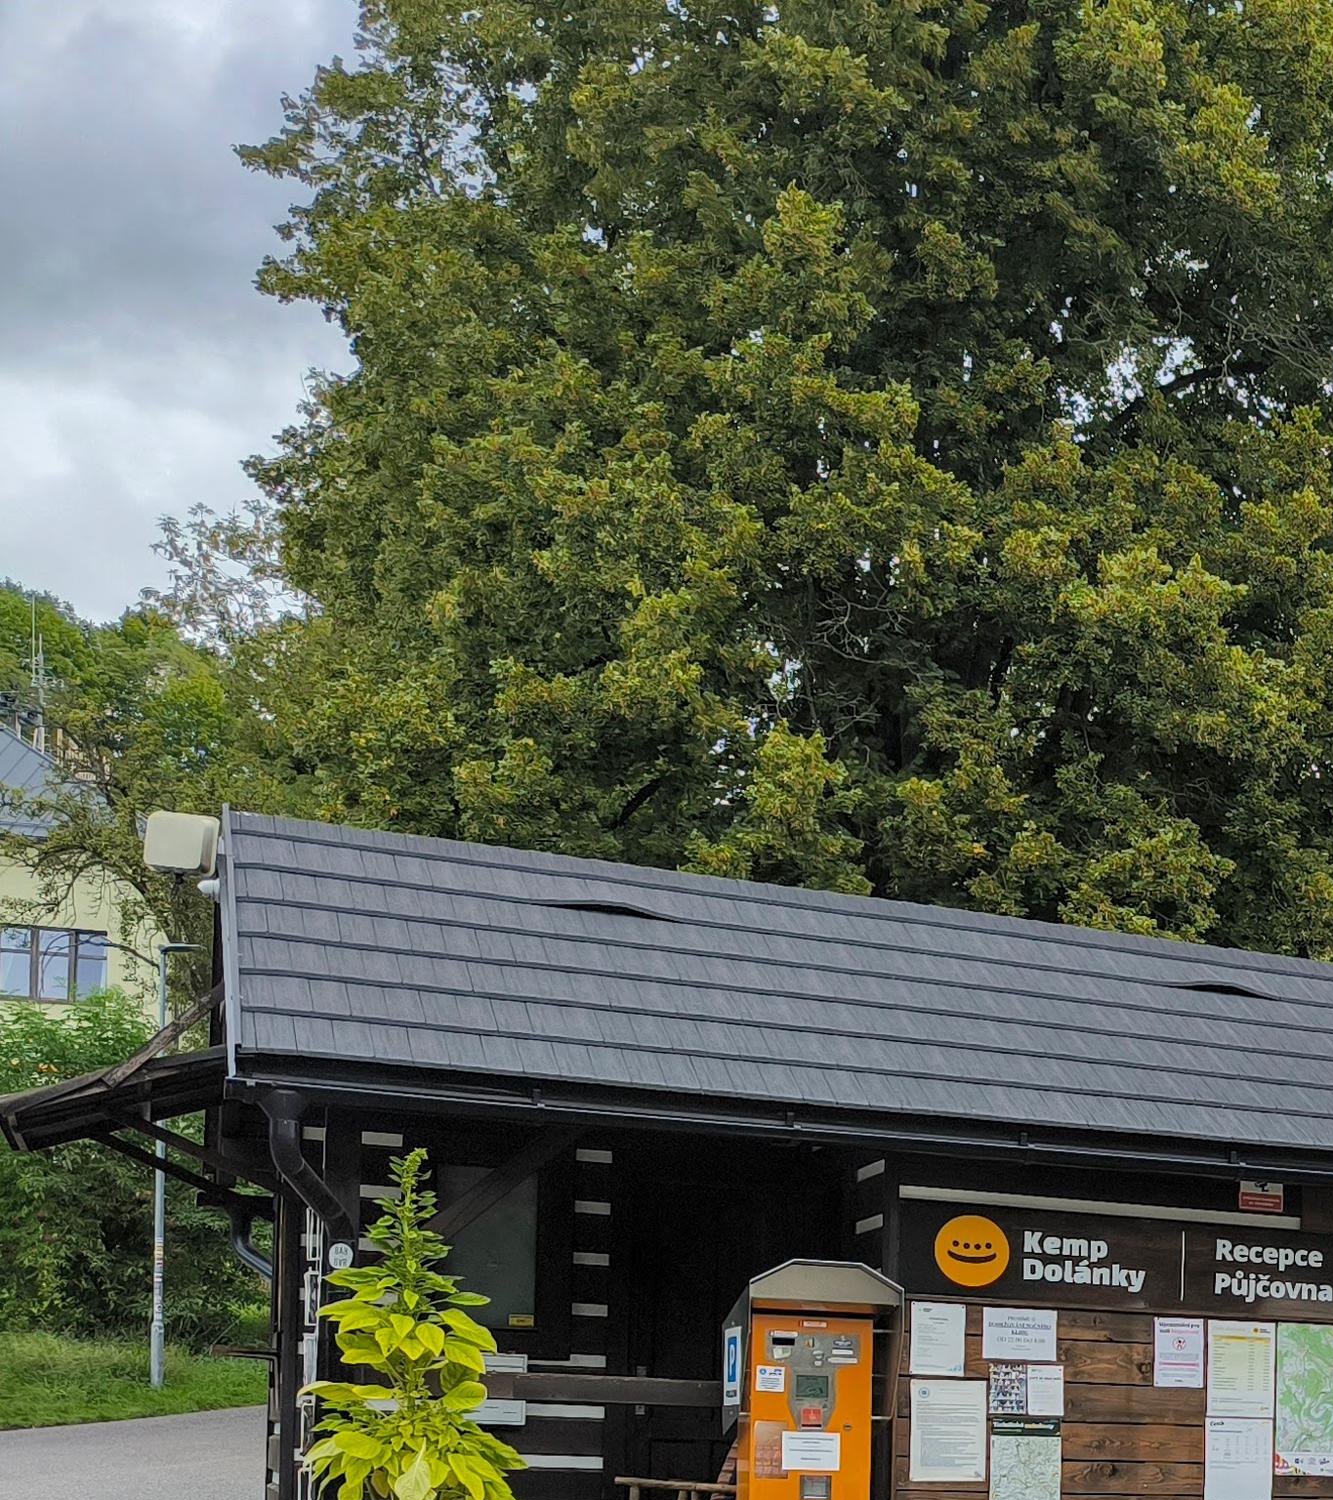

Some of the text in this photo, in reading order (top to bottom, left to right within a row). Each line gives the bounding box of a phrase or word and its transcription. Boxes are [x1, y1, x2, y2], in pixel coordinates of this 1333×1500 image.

[1022, 1230, 1109, 1263] Kemp
[1215, 1238, 1323, 1271] Recepce
[1022, 1258, 1146, 1293] Dolánky
[1214, 1270, 1333, 1303] Půjčovna
